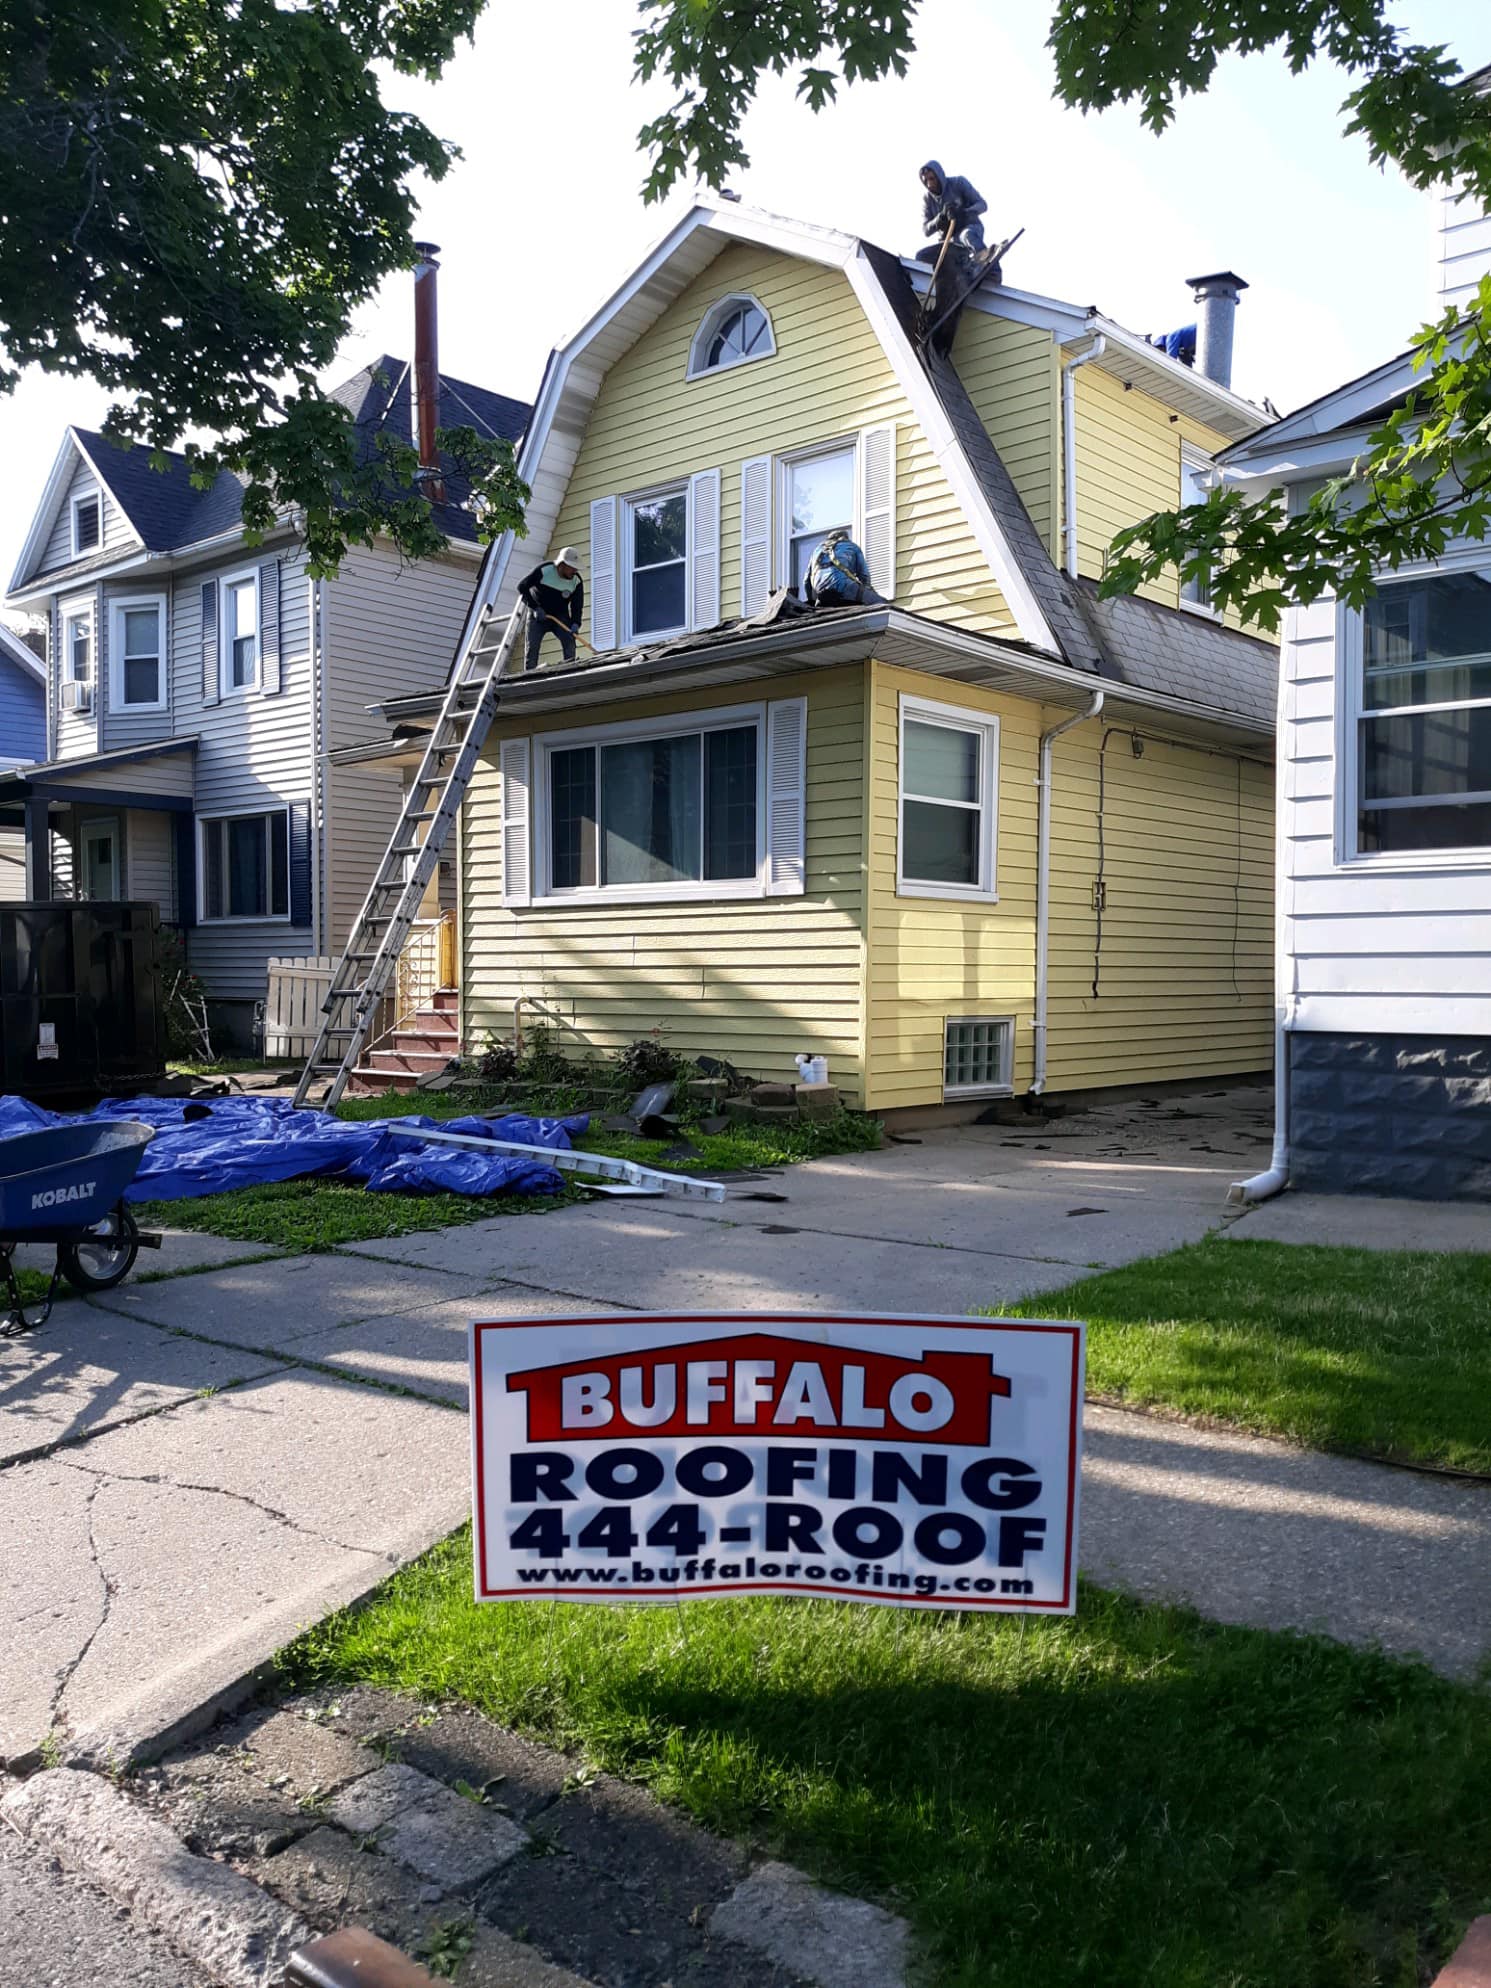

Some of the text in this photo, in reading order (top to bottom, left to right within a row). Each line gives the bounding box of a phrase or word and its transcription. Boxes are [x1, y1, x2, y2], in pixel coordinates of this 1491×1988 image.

[31, 1182, 97, 1210] KOBALT
[561, 1359, 956, 1433] BUFFALO
[510, 1446, 1043, 1511] ROOFING
[509, 1502, 1047, 1568] 444-ROOF
[516, 1557, 1034, 1595] www.buffaloroofing.com
